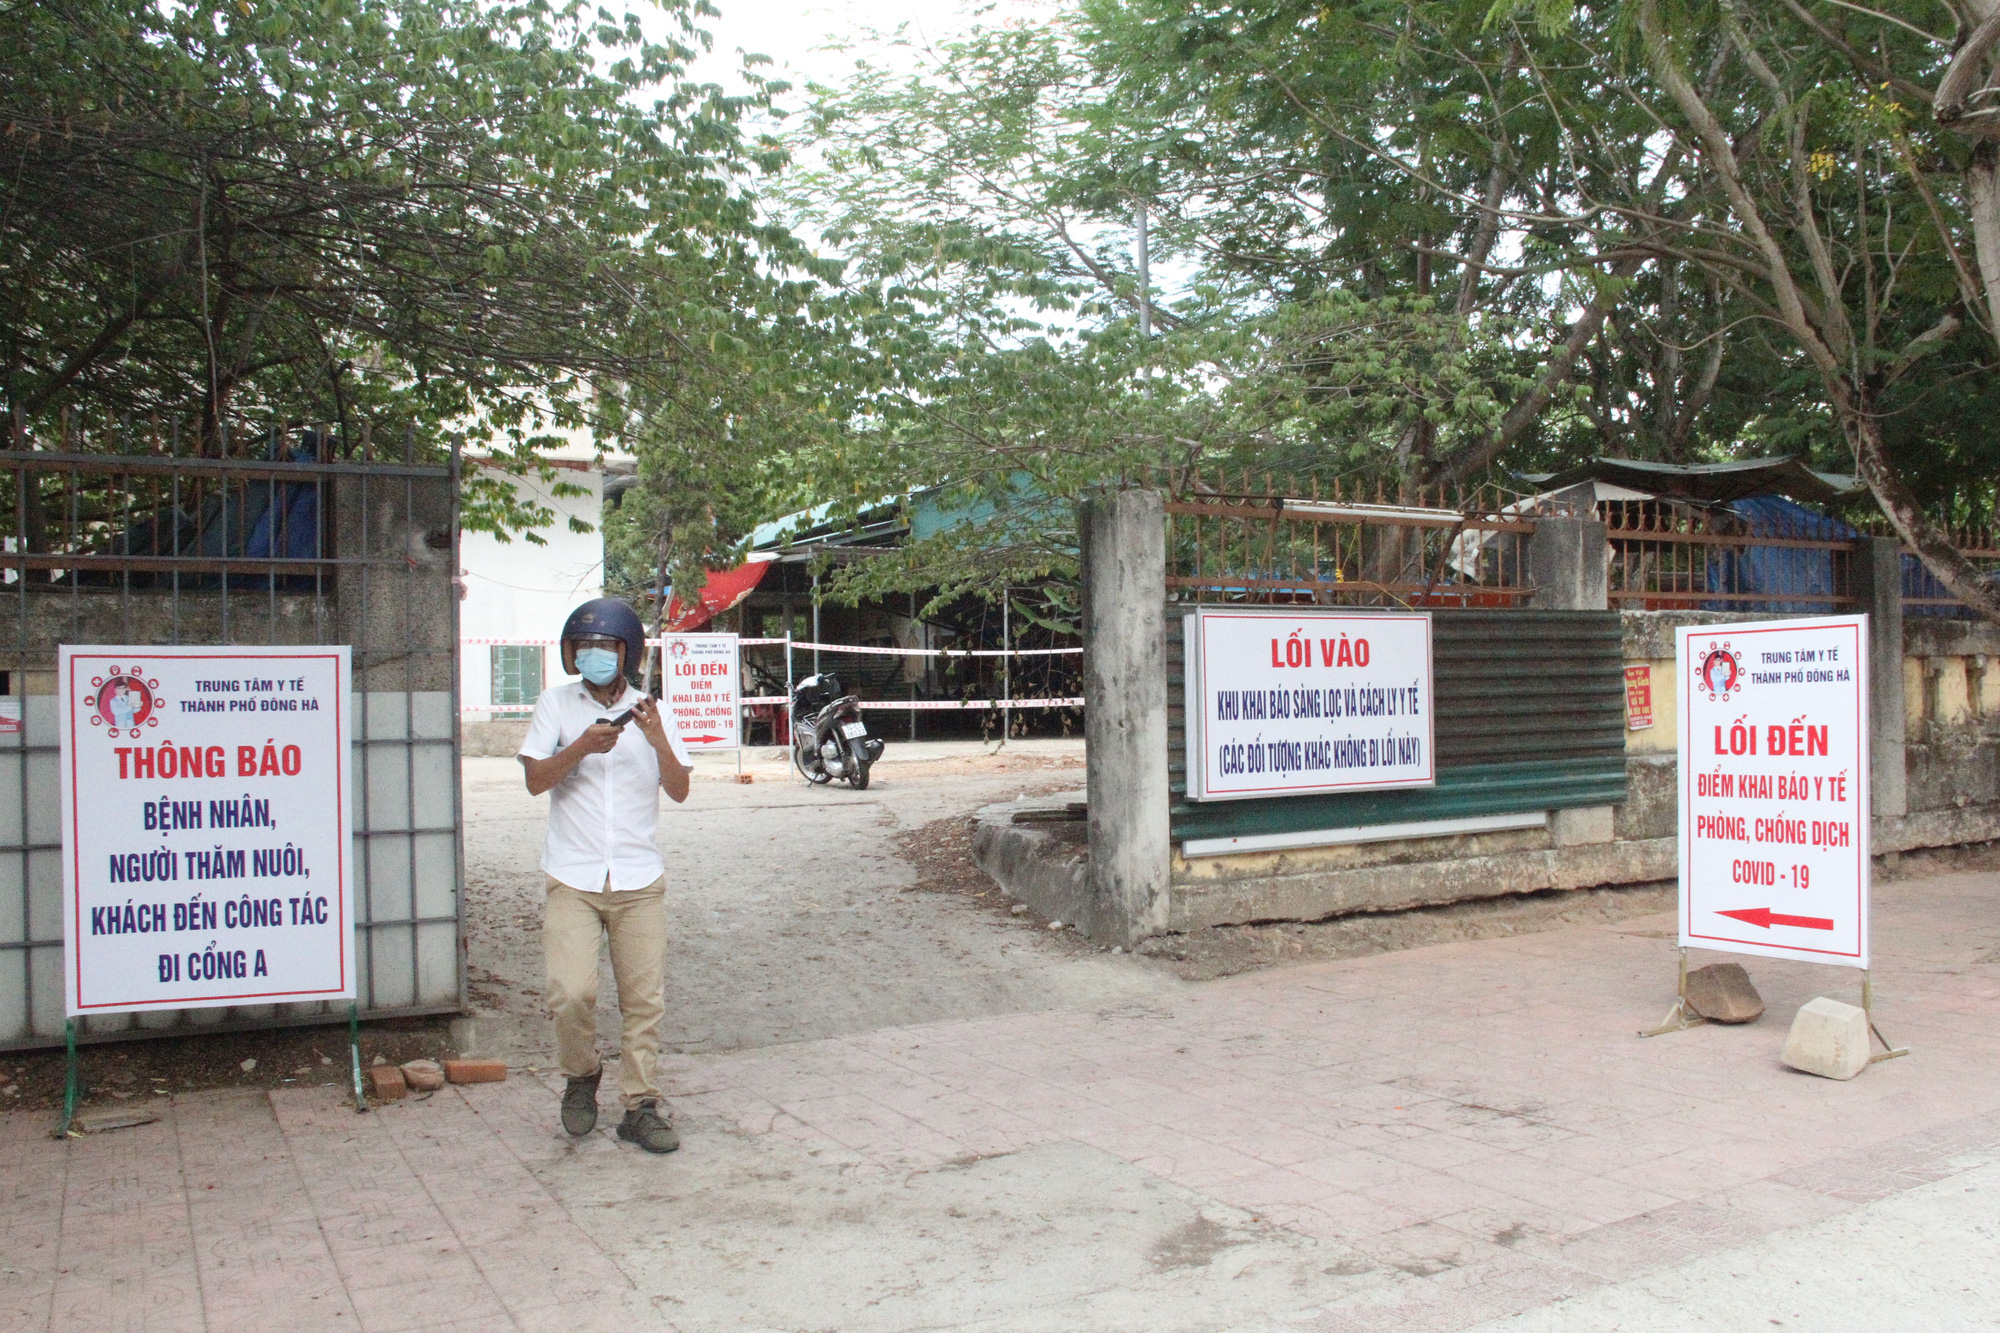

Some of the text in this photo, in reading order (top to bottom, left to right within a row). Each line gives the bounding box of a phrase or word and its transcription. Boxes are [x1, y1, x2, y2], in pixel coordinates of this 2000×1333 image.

[675, 659, 728, 676] LỐI ĐẾN
[1272, 628, 1370, 668] LỐI VÀO
[1762, 645, 1839, 664] TRUNG TÂM Y TẾ
[195, 675, 305, 693] TRUNG TÂM Y TẾ
[1752, 667, 1850, 684] THÀNH PHỐ ĐÔNG HÀ
[180, 695, 320, 713] THÀNH PHỐ ĐÔNG HÀ
[673, 690, 731, 703] KHAI BÁO Y TẾ
[705, 704, 732, 716] CHỐNG
[1217, 678, 1419, 724] KHU KHAI BÁO SÀNG LỌC VÀ CÁCH LY Y TẾ
[693, 720, 716, 729] COVID
[724, 720, 734, 729] 19
[1715, 714, 1829, 756] LỐI ĐẾN
[114, 738, 302, 780] THÔNG BÁO
[1219, 728, 1421, 778] (CÁC ĐỐI TƯỢNG KHÁC KHÔNG ĐI LỐI NÀY)
[1698, 764, 1847, 802] ĐIỂM KHAI BÁO Y TẾ
[143, 793, 277, 837] BỆNH NHÂN,
[1698, 810, 1849, 852] PHÒNG, CHỐNG DỊCH
[110, 842, 310, 884] NGƯỜI THĂM NUÔI,
[1733, 860, 1775, 886] COVID
[1792, 864, 1810, 889] 19
[91, 891, 328, 936] KHÁCH ĐẾN CÔNG TÁC
[158, 940, 268, 983] ĐI CỔNG A
